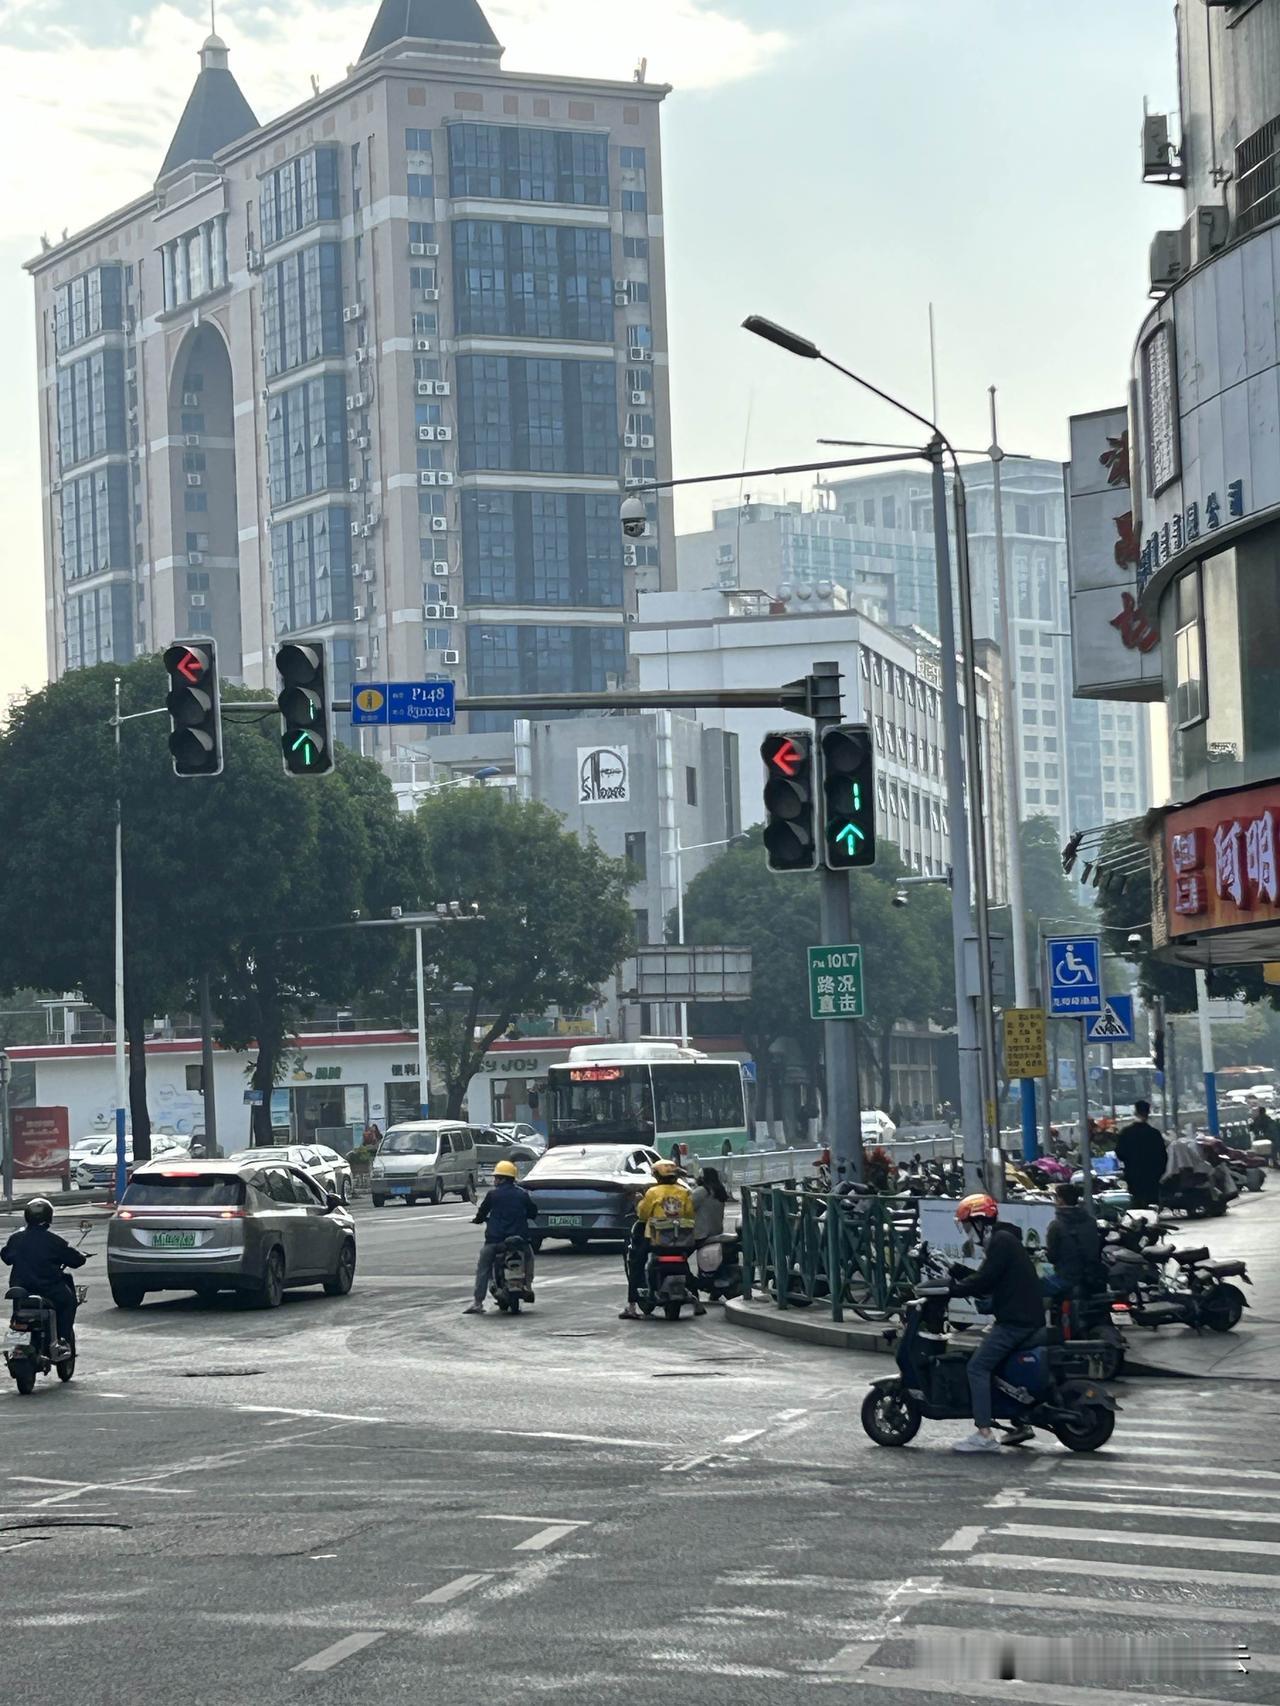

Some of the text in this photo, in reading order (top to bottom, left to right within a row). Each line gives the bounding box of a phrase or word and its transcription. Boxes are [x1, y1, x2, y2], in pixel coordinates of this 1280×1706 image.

[412, 688, 445, 702] P148
[817, 974, 856, 994] 路况
[818, 993, 856, 1013] 直击
[501, 1059, 538, 1073] JOY
